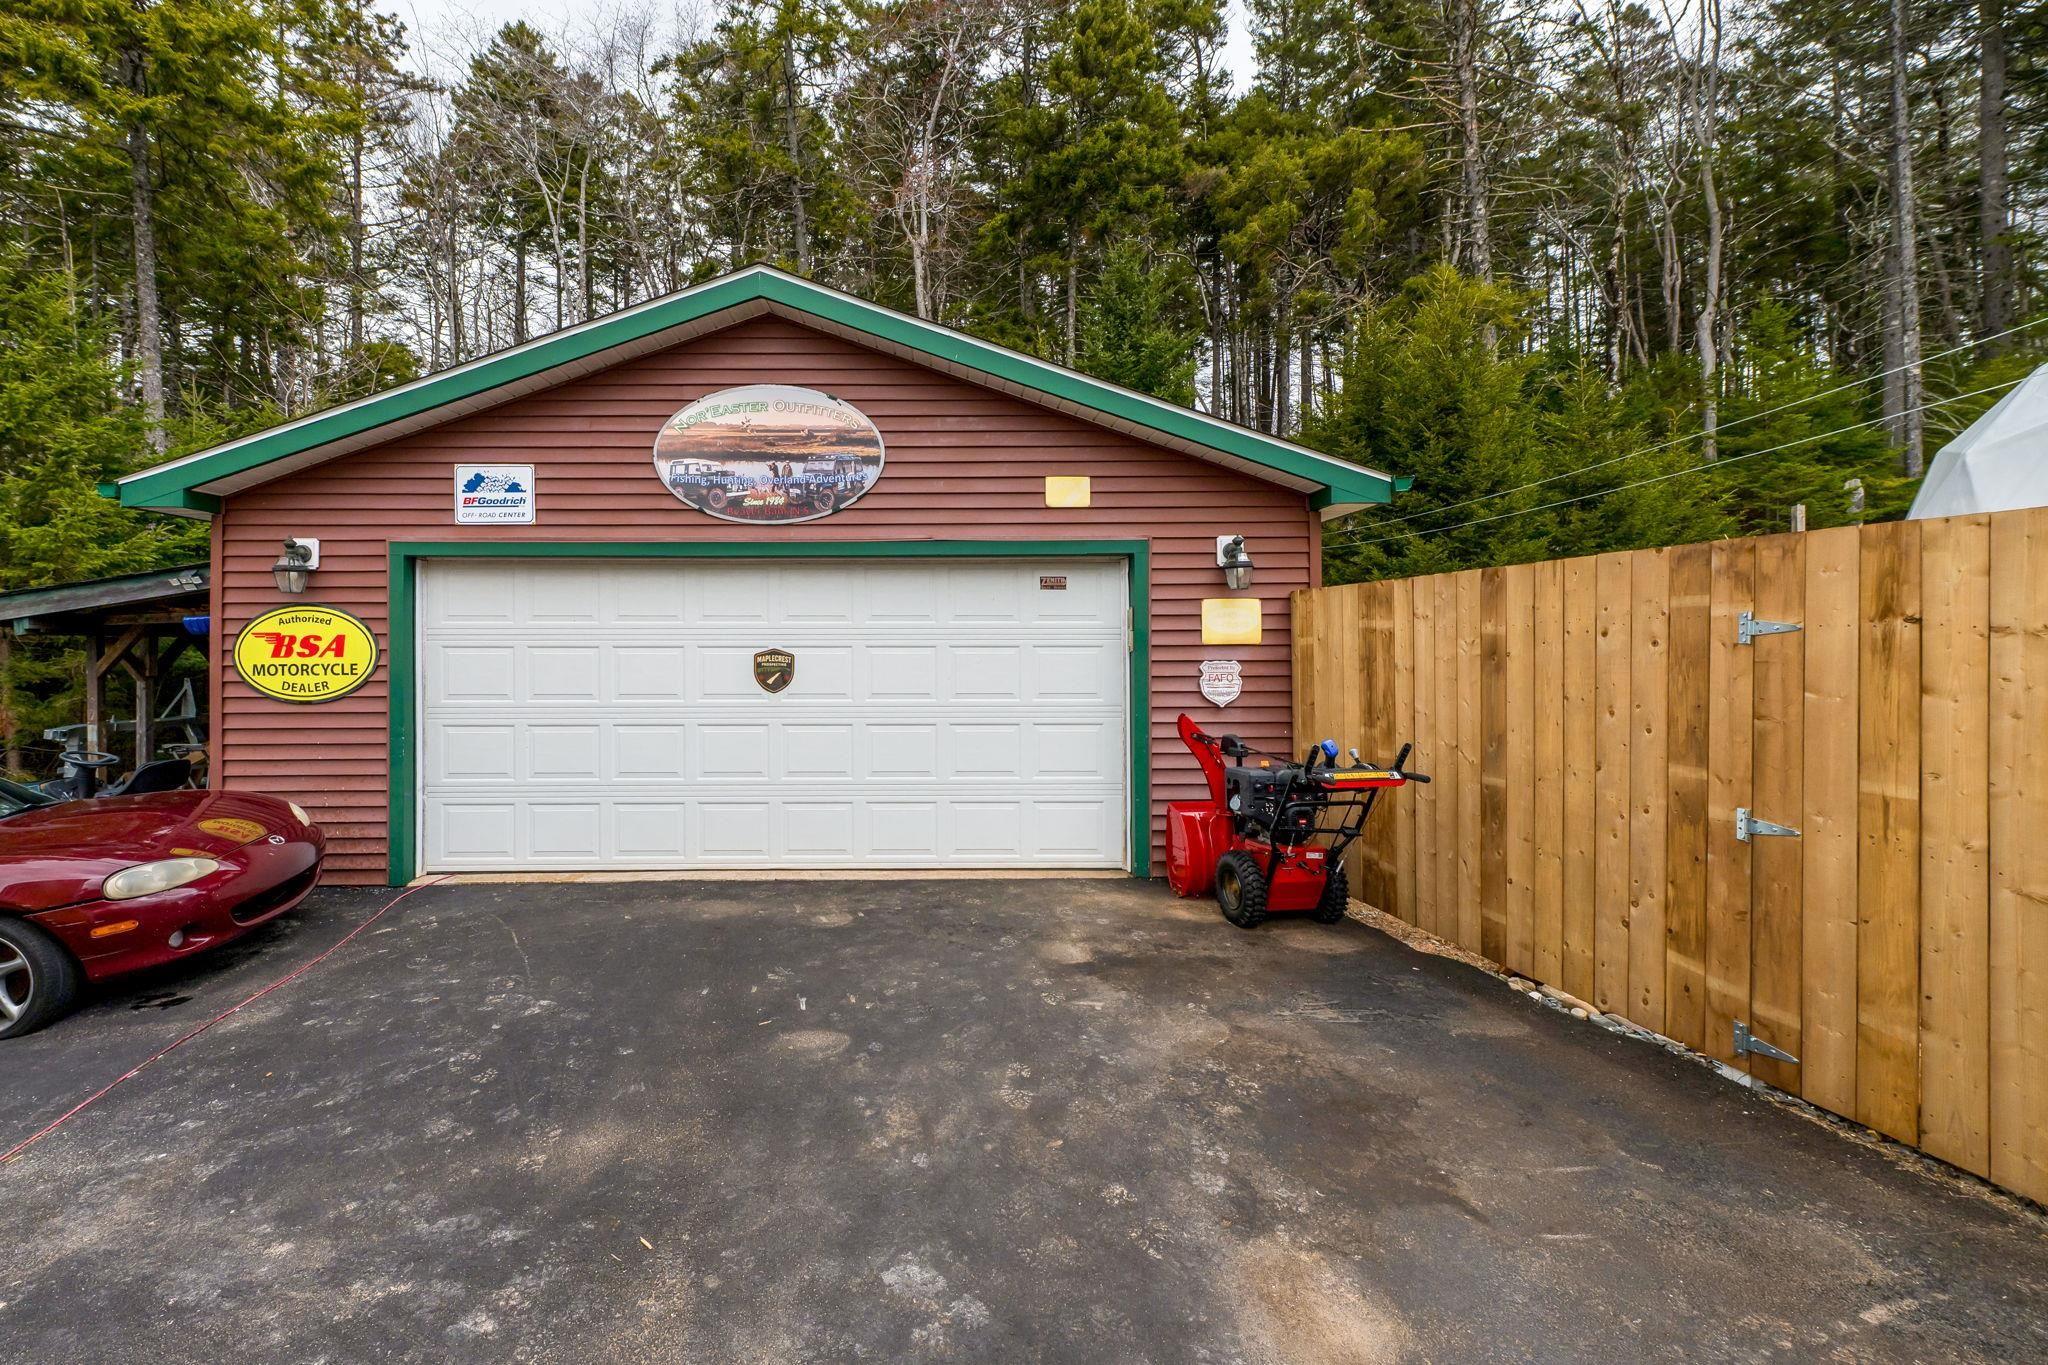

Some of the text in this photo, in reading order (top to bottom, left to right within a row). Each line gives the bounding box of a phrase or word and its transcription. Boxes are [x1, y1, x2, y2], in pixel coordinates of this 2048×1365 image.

[673, 400, 861, 434] NOR'EASTER OUTFITTERS
[671, 471, 868, 487] Fishing, Hunting, Overland Adventures
[463, 497, 527, 505] BFGoodrich
[278, 615, 332, 626] Authorized
[252, 632, 346, 658] BSA
[757, 654, 792, 663] MAPLECREST
[252, 663, 358, 676] MOTORCYCLE
[281, 681, 330, 693] DEALER
